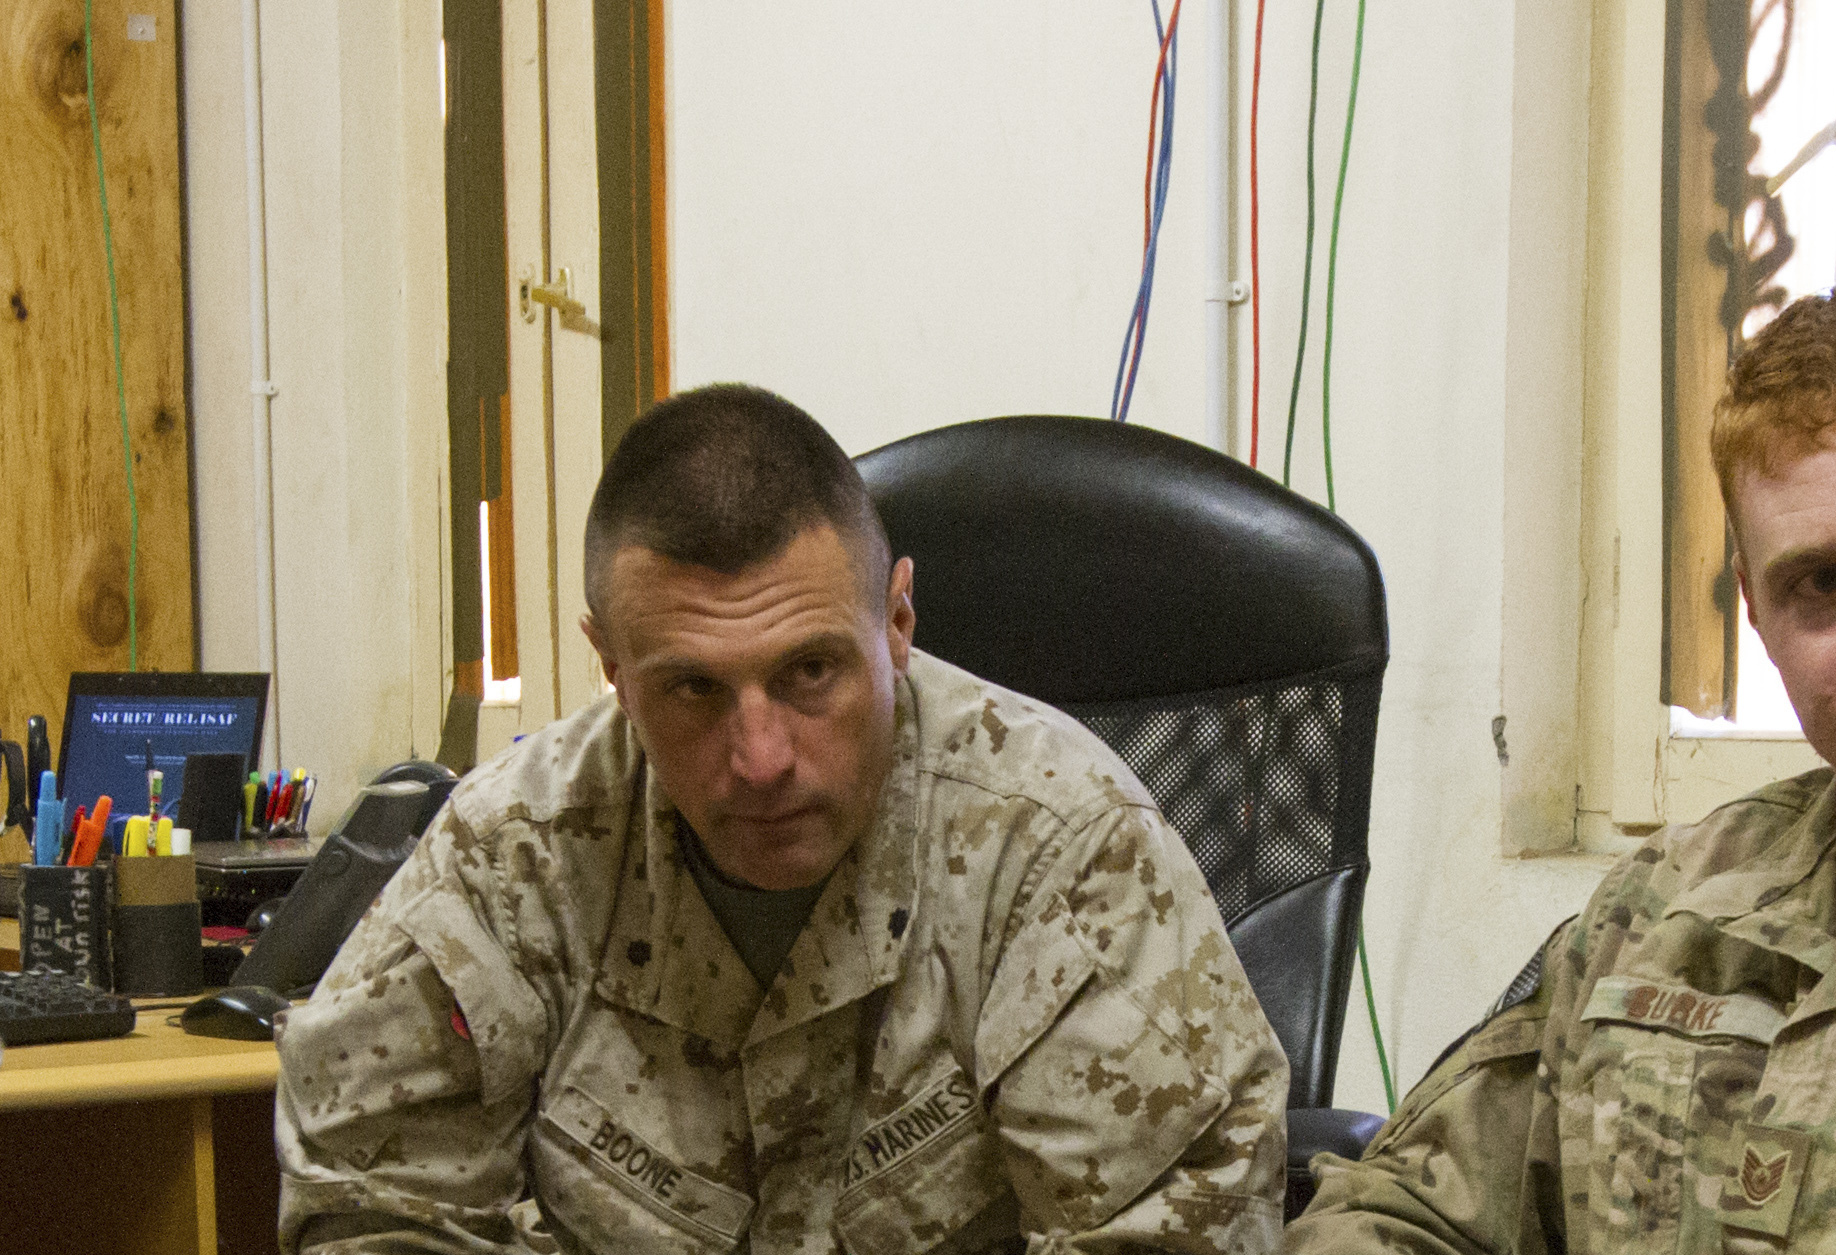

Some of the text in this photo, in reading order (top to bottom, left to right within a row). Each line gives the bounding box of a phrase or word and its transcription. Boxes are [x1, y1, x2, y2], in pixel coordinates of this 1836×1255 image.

[91, 712, 156, 724] SECRET
[590, 1121, 683, 1198] BOONE
[863, 1080, 976, 1168] MARINES
